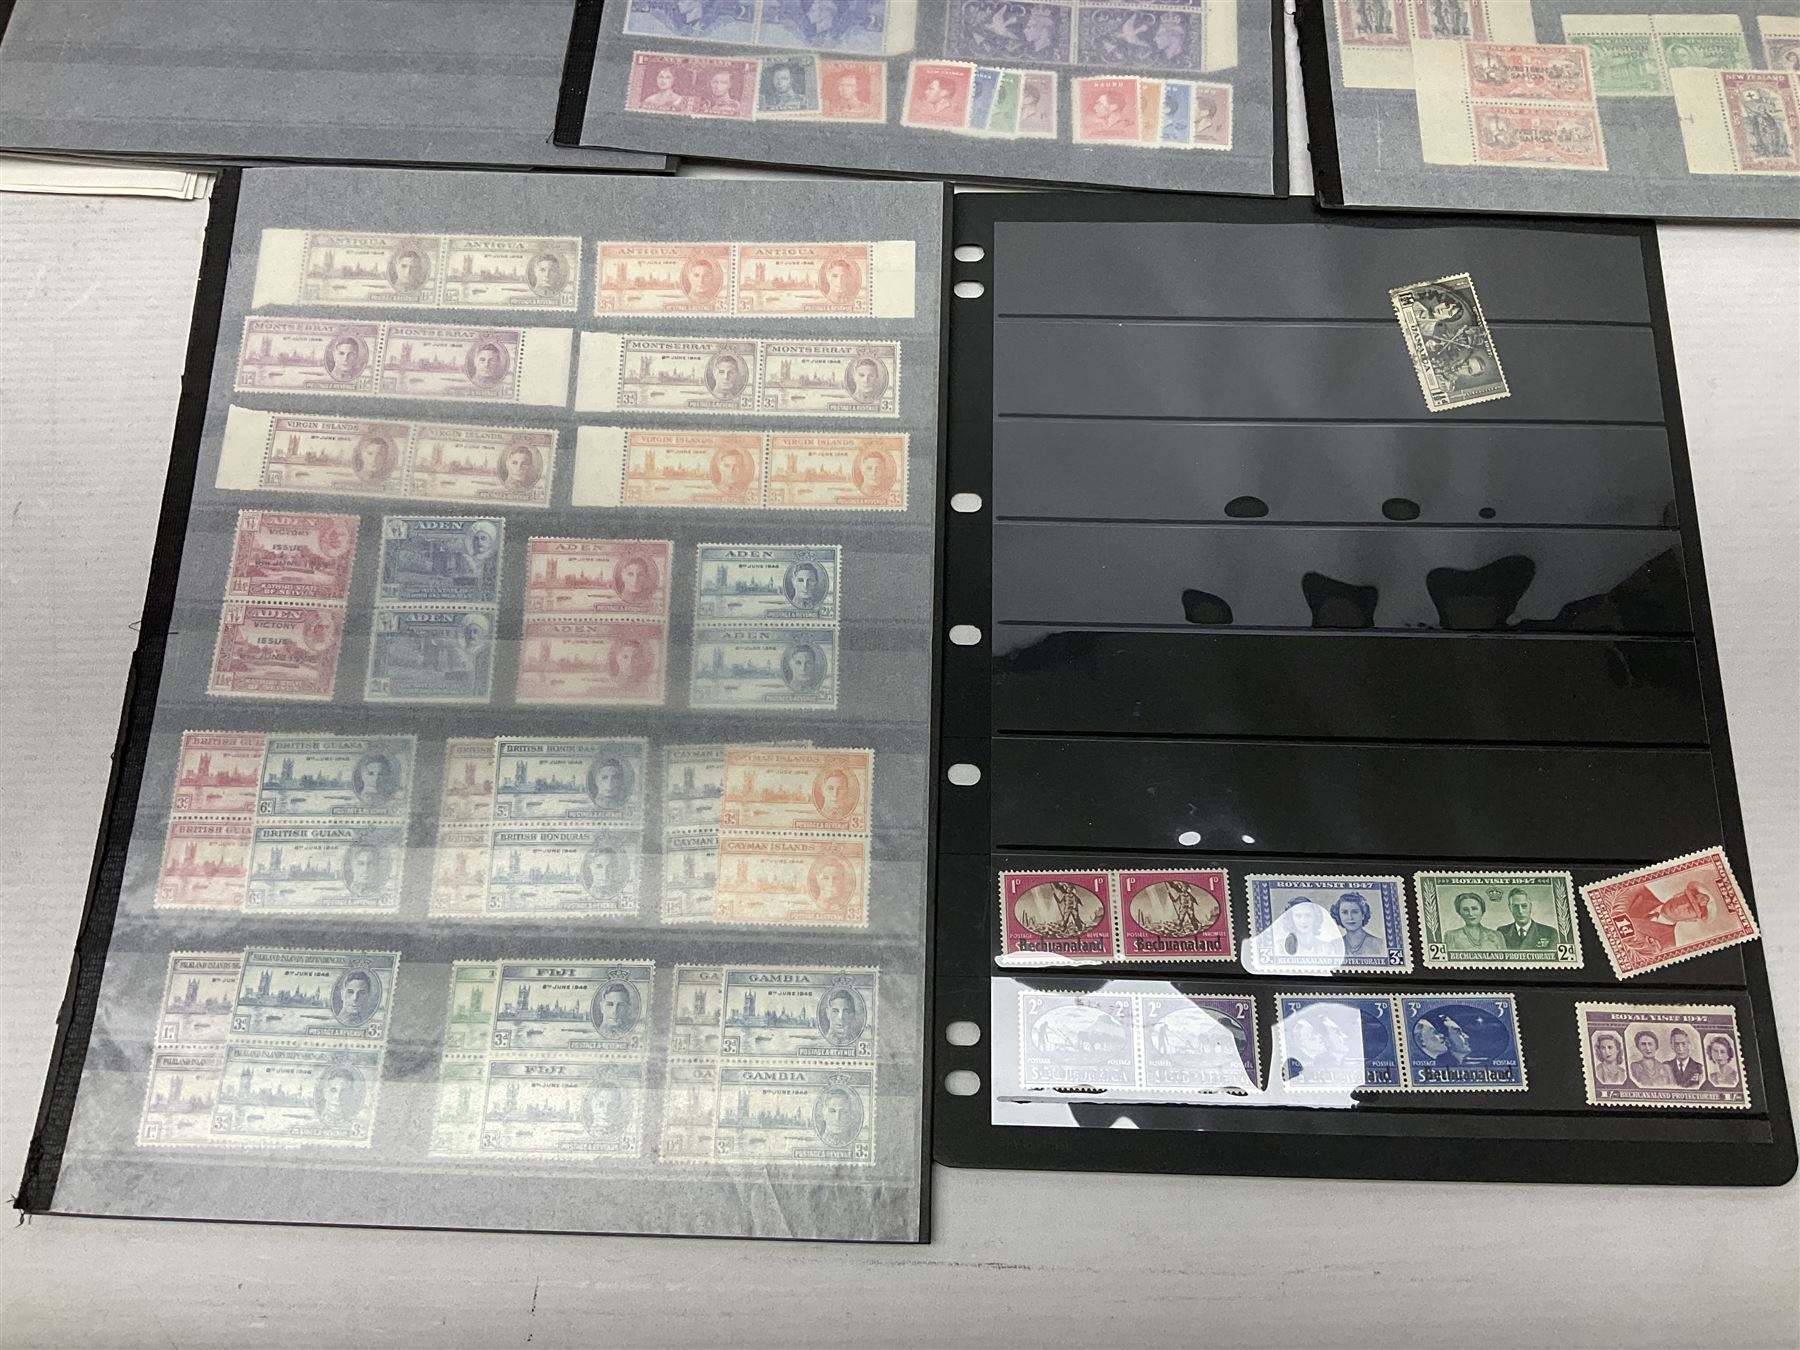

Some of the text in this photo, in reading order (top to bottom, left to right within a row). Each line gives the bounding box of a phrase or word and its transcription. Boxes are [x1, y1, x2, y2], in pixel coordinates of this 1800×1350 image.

[394, 328, 475, 337] MONTSERRAT
[632, 342, 712, 350] MONTSERRAT
[1411, 325, 1430, 372] JAMAICA
[288, 421, 359, 431] VIRGIN ISLANDS
[415, 521, 464, 530] ADEN
[555, 542, 600, 550] ADEN
[253, 610, 303, 619] ADEN
[406, 614, 455, 622] ADEN
[553, 625, 598, 633] ADEN
[723, 632, 771, 640] ADEN
[257, 637, 289, 645] ISSUE
[193, 738, 236, 746] BRITISH
[275, 742, 362, 750] BRITISH GUIANA
[179, 825, 223, 834] BRITISH
[263, 829, 352, 838] BRITISH GUIANA
[674, 838, 713, 846] CAYMAN
[728, 842, 768, 850] CAYMAN
[1094, 878, 1103, 892] 1D
[1715, 861, 1751, 929] ROYAL VISIT
[1717, 881, 1736, 911] 1947
[1588, 892, 1628, 972] PROTECTORATE
[1593, 890, 1632, 970] BECHUANALAND
[1019, 937, 1104, 952] Bechuanaland
[1136, 936, 1222, 951] Bechuanaland
[1450, 952, 1504, 960] BECHUANALAND
[749, 974, 810, 983] GAMBIA
[1235, 1003, 1248, 1019] 2D
[1375, 1003, 1387, 1019] 3D
[1408, 1002, 1421, 1017] 3D
[1494, 1002, 1508, 1017] 3D
[524, 1066, 566, 1074] FIJI
[743, 1072, 806, 1081] GAMBIA
[1619, 1091, 1670, 1099] BECHUANALAND
[1672, 1092, 1720, 1100] PROTECTORATE
